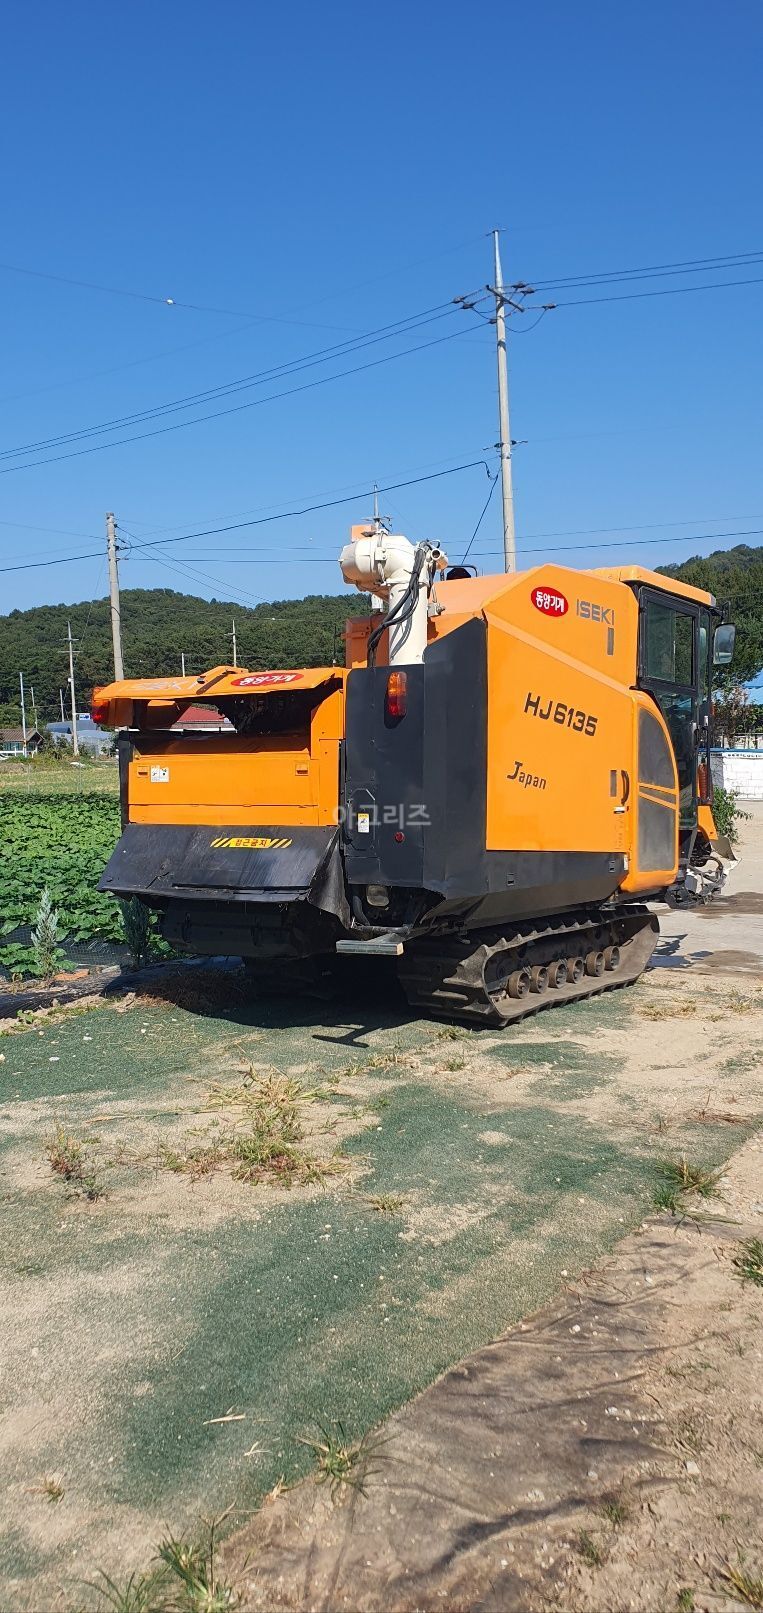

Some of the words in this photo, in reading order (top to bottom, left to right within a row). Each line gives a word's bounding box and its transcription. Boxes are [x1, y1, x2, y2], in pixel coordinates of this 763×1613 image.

[536, 591, 565, 613] 동양기계
[576, 598, 615, 626] ISEKI
[506, 760, 547, 790] Japan
